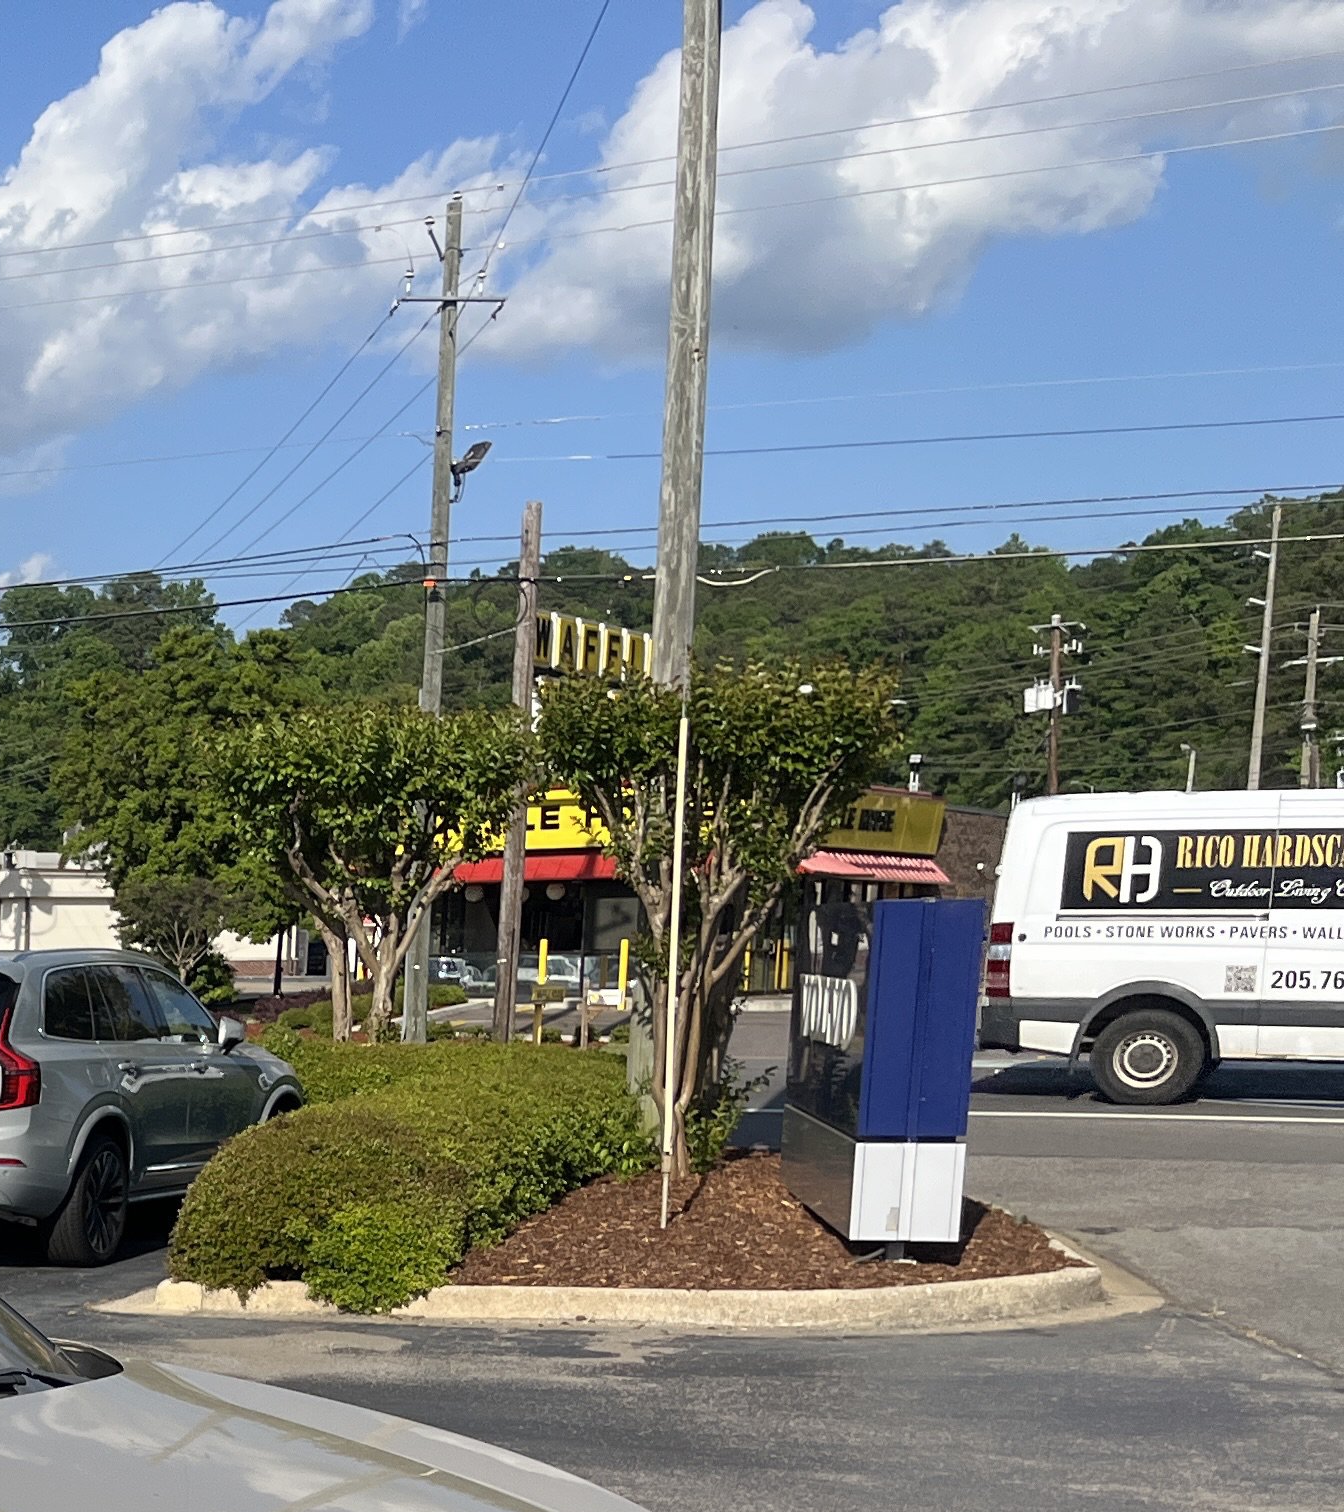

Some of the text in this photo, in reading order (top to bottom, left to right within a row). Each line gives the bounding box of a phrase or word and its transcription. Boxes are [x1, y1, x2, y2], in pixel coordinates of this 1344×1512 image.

[1175, 834, 1344, 868] RICO HARDSC
[1209, 879, 1271, 898] Outdoor
[1275, 879, 1332, 904] Living
[1044, 925, 1092, 938] POOLS
[1105, 925, 1154, 938] STONE
[1161, 925, 1215, 938] WORKS
[1230, 926, 1288, 939] PAVERS
